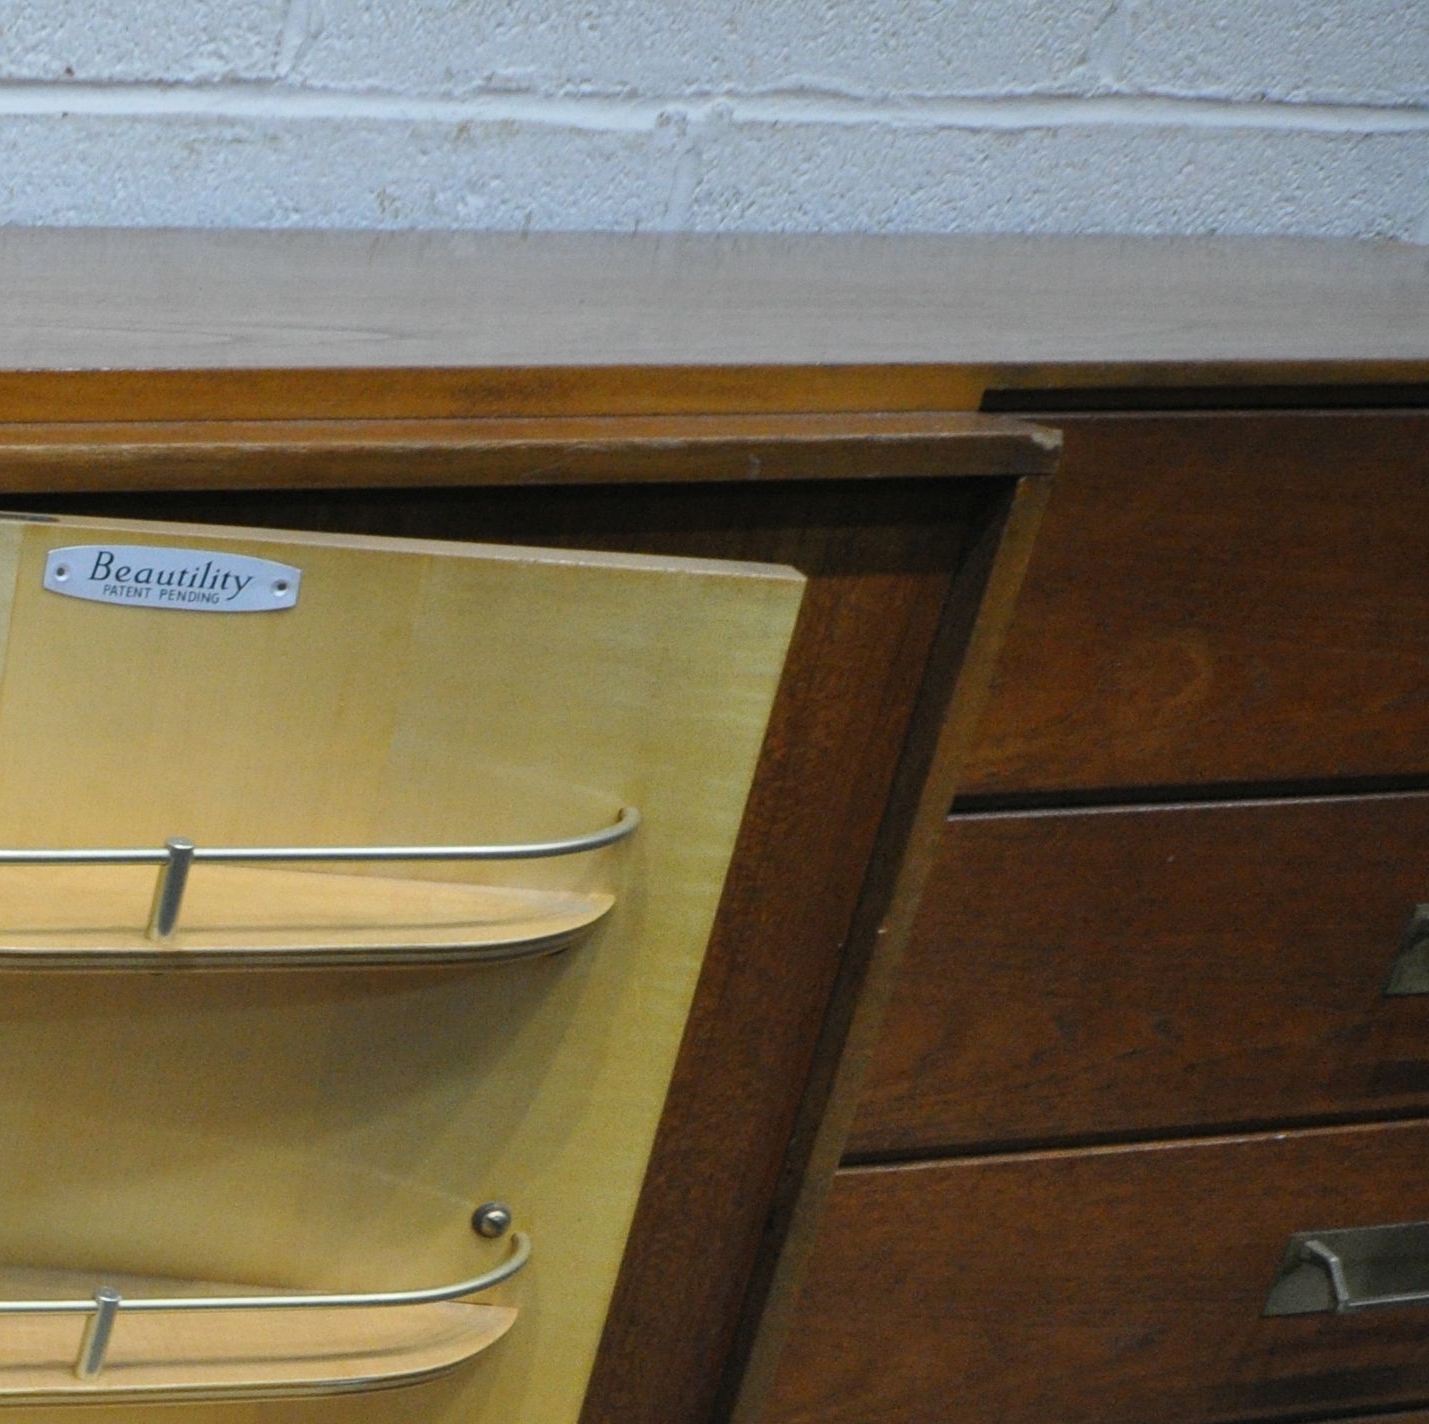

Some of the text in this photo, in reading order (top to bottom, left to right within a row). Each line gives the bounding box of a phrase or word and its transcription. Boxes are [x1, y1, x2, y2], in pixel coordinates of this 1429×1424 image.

[89, 551, 253, 600] Beautility
[103, 584, 220, 604] PATENT PENDING
